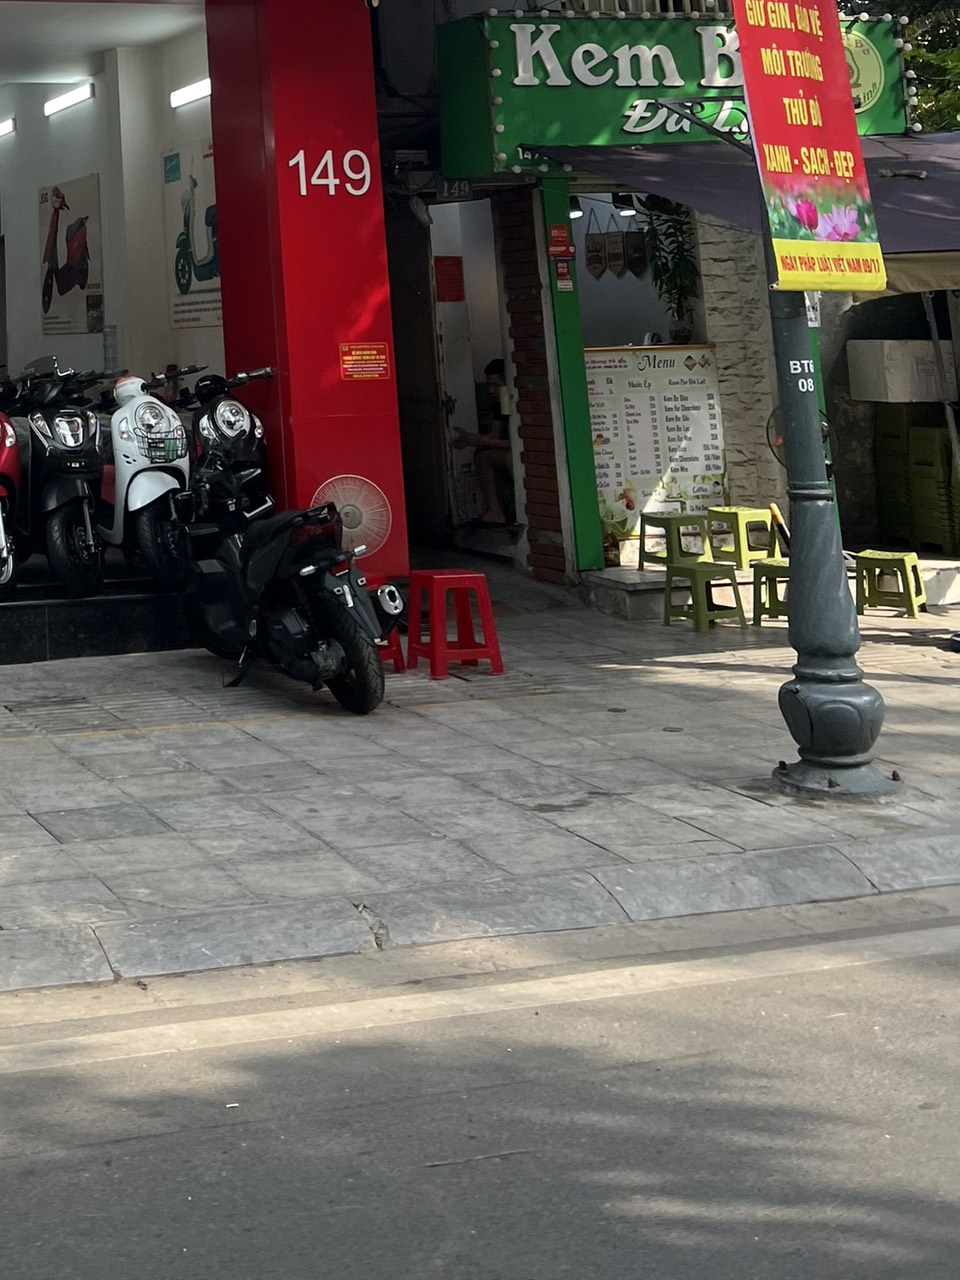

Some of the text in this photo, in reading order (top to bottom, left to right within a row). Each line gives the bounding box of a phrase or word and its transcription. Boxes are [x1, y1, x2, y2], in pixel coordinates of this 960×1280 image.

[509, 23, 744, 87] Kem B
[760, 43, 787, 76] MÔI
[782, 89, 809, 126] THỦ
[288, 149, 372, 197] 149
[762, 143, 793, 173] XANH
[800, 146, 831, 181] SẠCH
[442, 180, 469, 197] 149
[638, 355, 676, 371] Menu
[798, 378, 814, 392] 08
